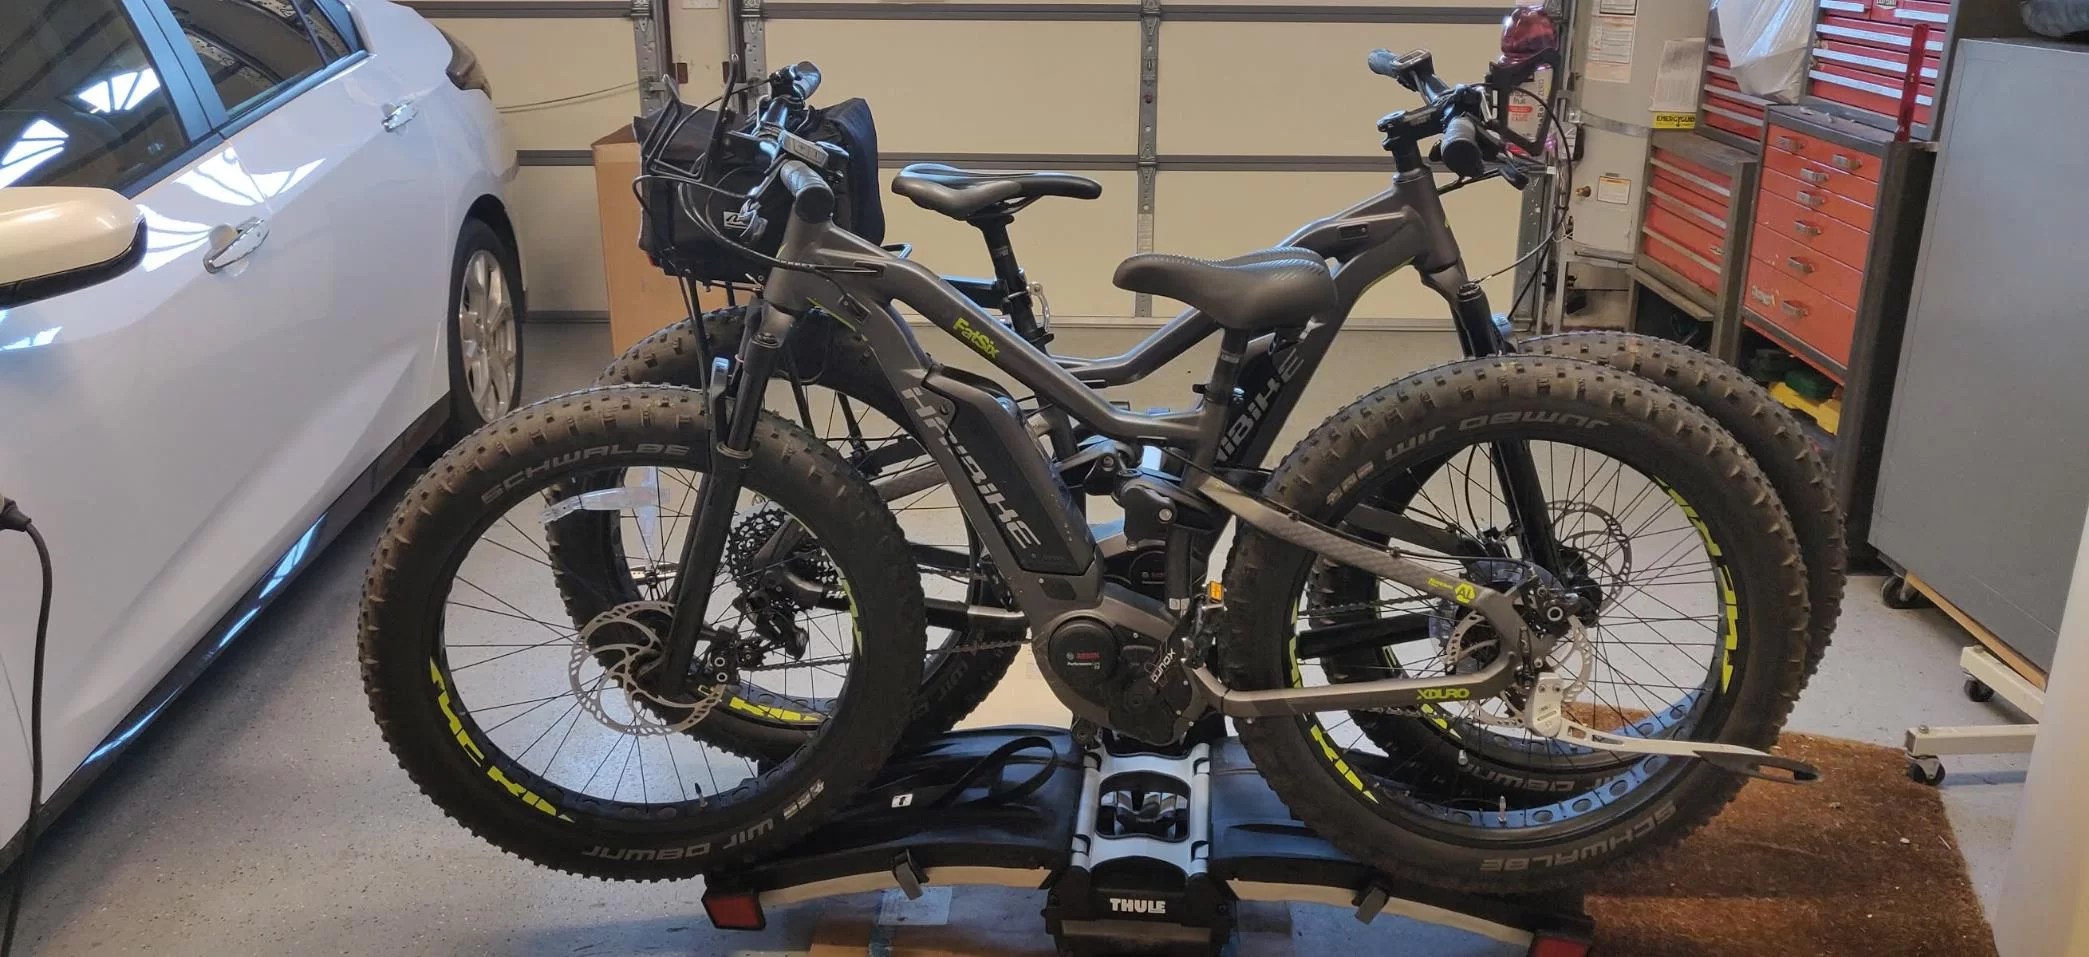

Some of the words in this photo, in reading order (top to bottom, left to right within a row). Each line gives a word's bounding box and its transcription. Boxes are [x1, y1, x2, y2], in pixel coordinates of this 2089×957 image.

[1656, 115, 1695, 125] ENERGYGUID
[953, 317, 1000, 358] FatSix
[481, 443, 690, 504] SCHWALBE
[1417, 687, 1470, 700] XDURO
[582, 842, 710, 861] JUMBO
[723, 818, 774, 849] JIM
[1480, 800, 1677, 872] SCHWALBE
[1109, 897, 1166, 914] THULE
